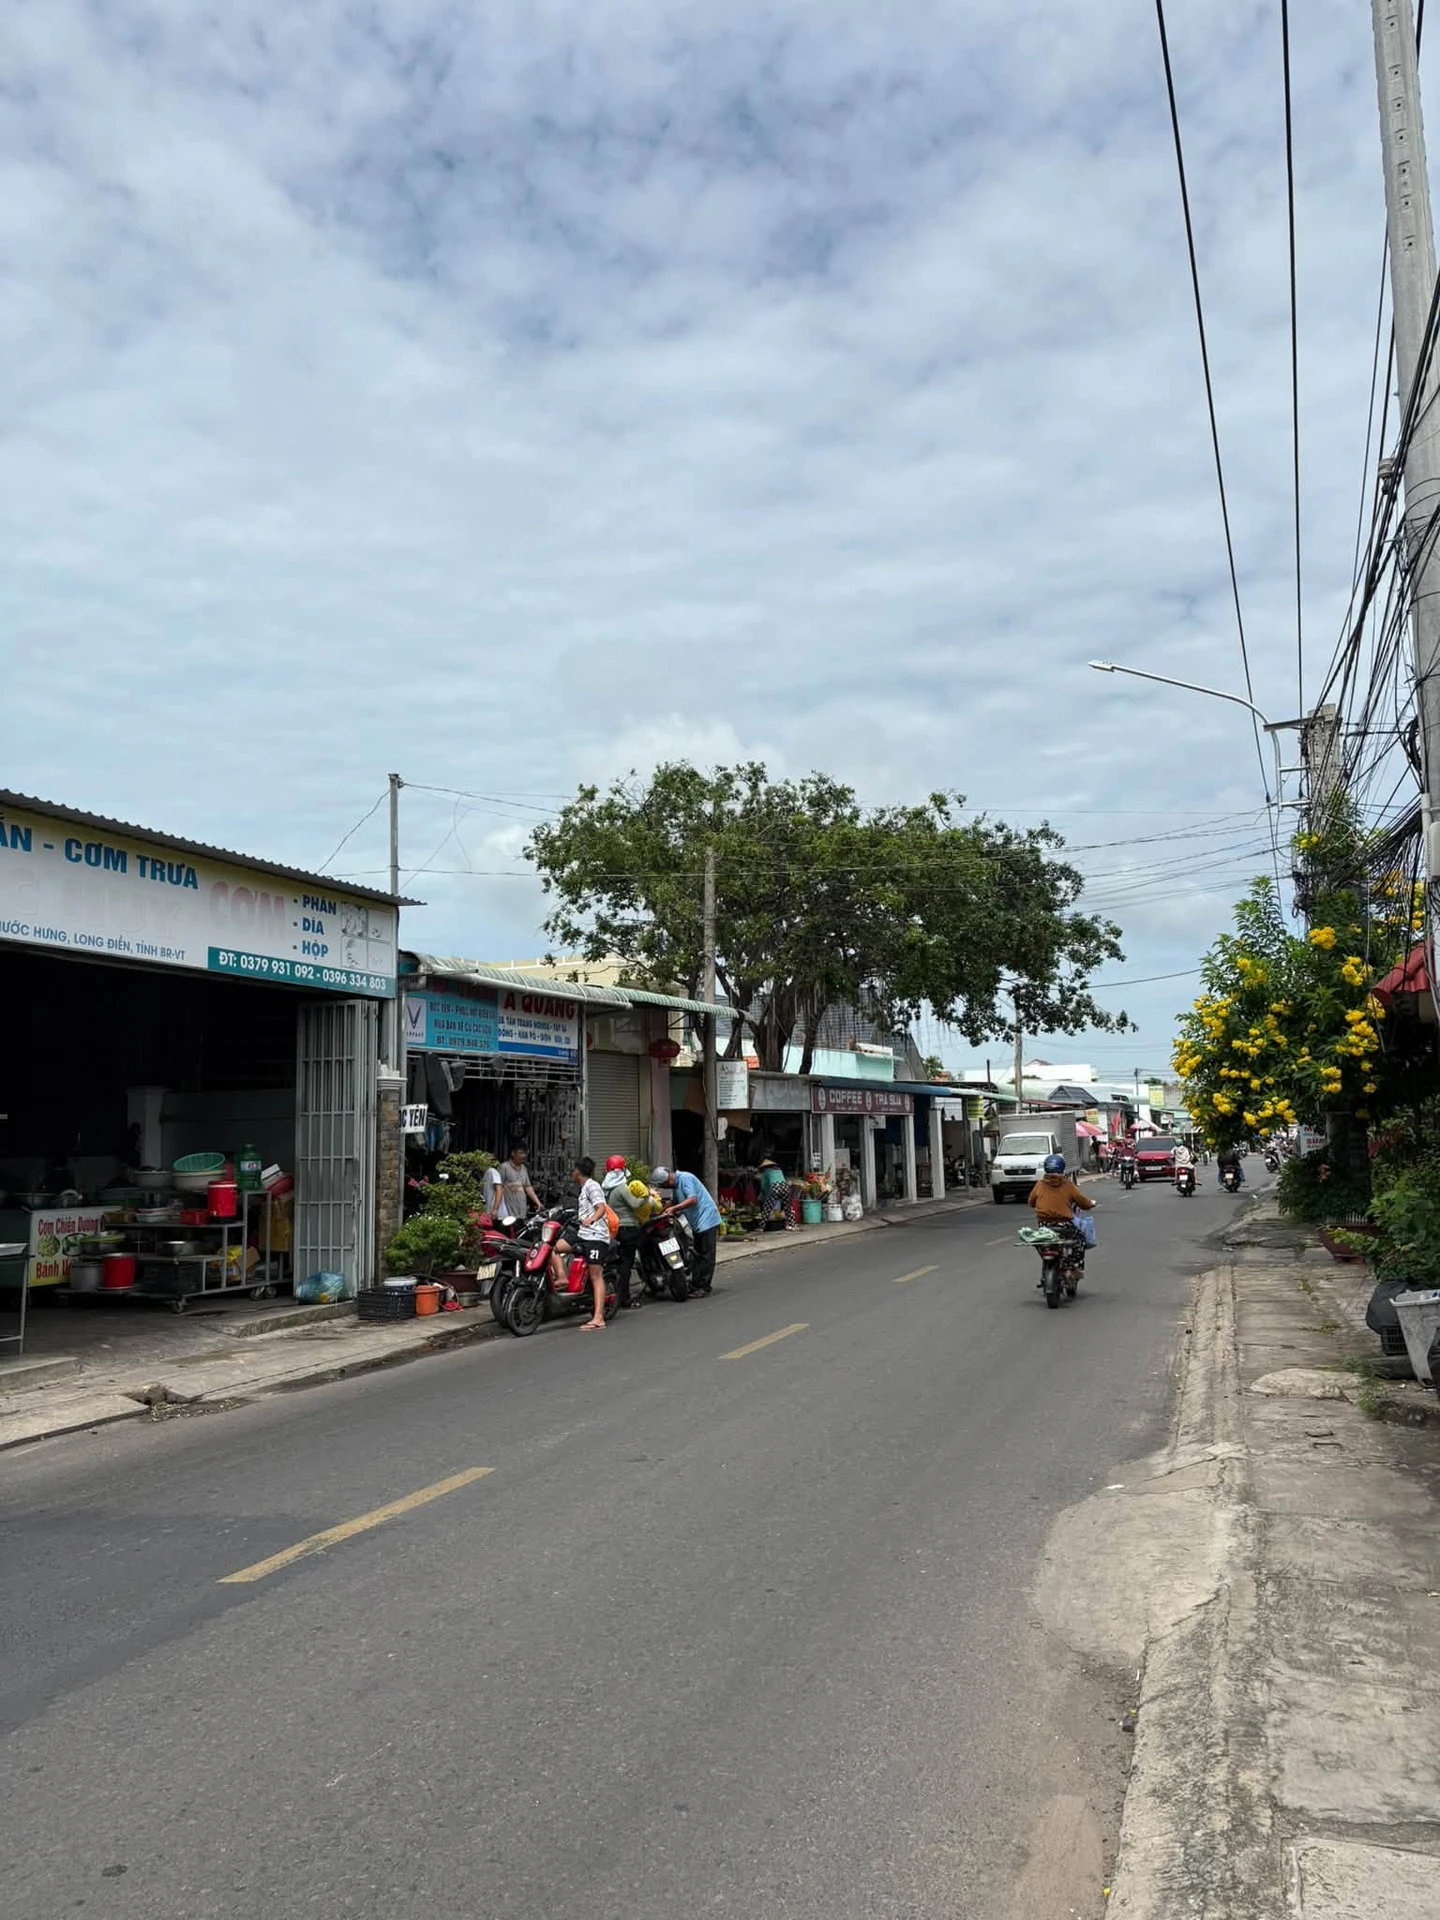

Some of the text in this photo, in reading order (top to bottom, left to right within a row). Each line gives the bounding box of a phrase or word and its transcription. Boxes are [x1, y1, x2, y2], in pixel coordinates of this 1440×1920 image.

[64, 838, 127, 874] CƠM
[136, 854, 199, 890] TRƯA
[33, 925, 71, 945] HƯNG,
[74, 933, 104, 948] LONG
[160, 947, 186, 961] BR-VT
[302, 939, 329, 961] HỘP
[218, 951, 237, 968] ĐT:
[240, 955, 269, 972] 0379
[271, 959, 291, 976] 931
[294, 963, 314, 980] 092
[322, 968, 347, 985] 0396
[350, 973, 367, 988] 334
[369, 977, 386, 991] 803
[521, 995, 575, 1020] QUANG
[829, 1088, 863, 1104] COFFEE
[589, 1250, 599, 1259] 21
